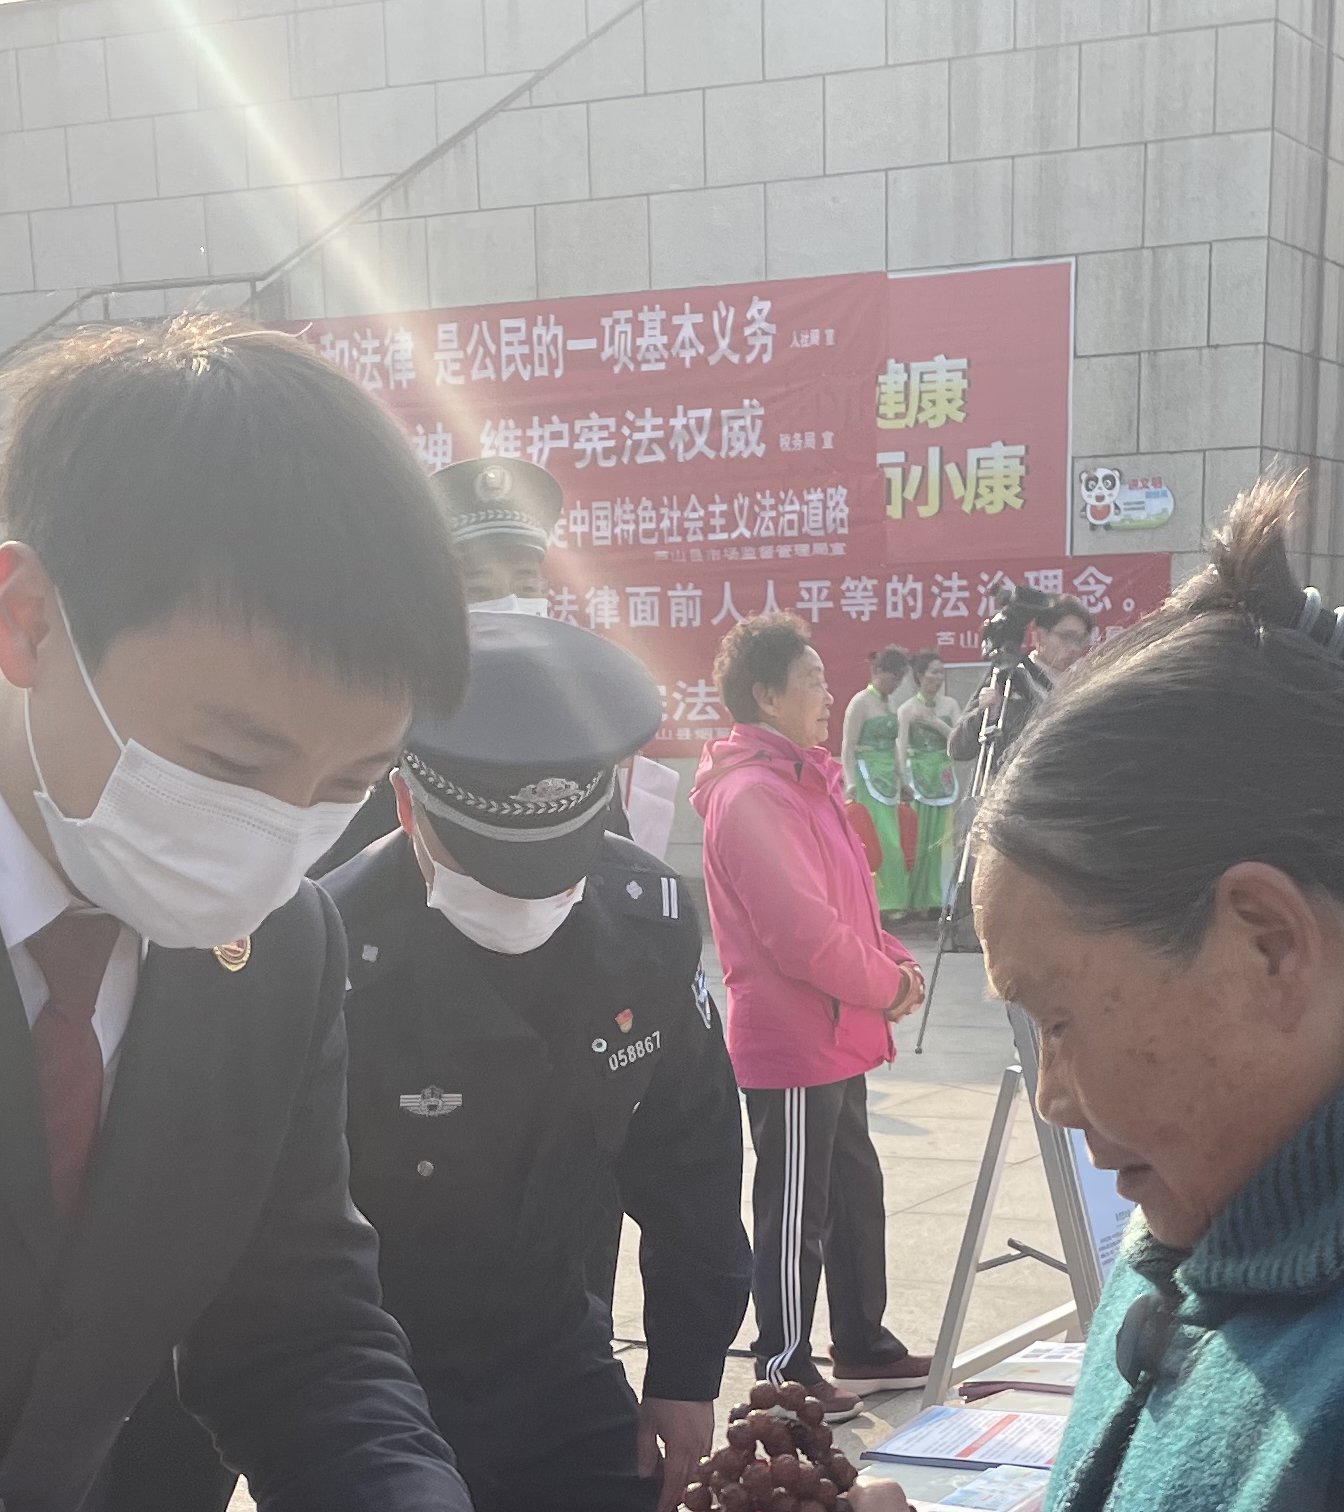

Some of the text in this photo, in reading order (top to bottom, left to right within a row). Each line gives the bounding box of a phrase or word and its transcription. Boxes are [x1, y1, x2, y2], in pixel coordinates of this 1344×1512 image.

[434, 296, 777, 386] 是公民的一项基本义务
[480, 398, 766, 468] 维护宪法权威
[608, 1031, 661, 1072] 058867
